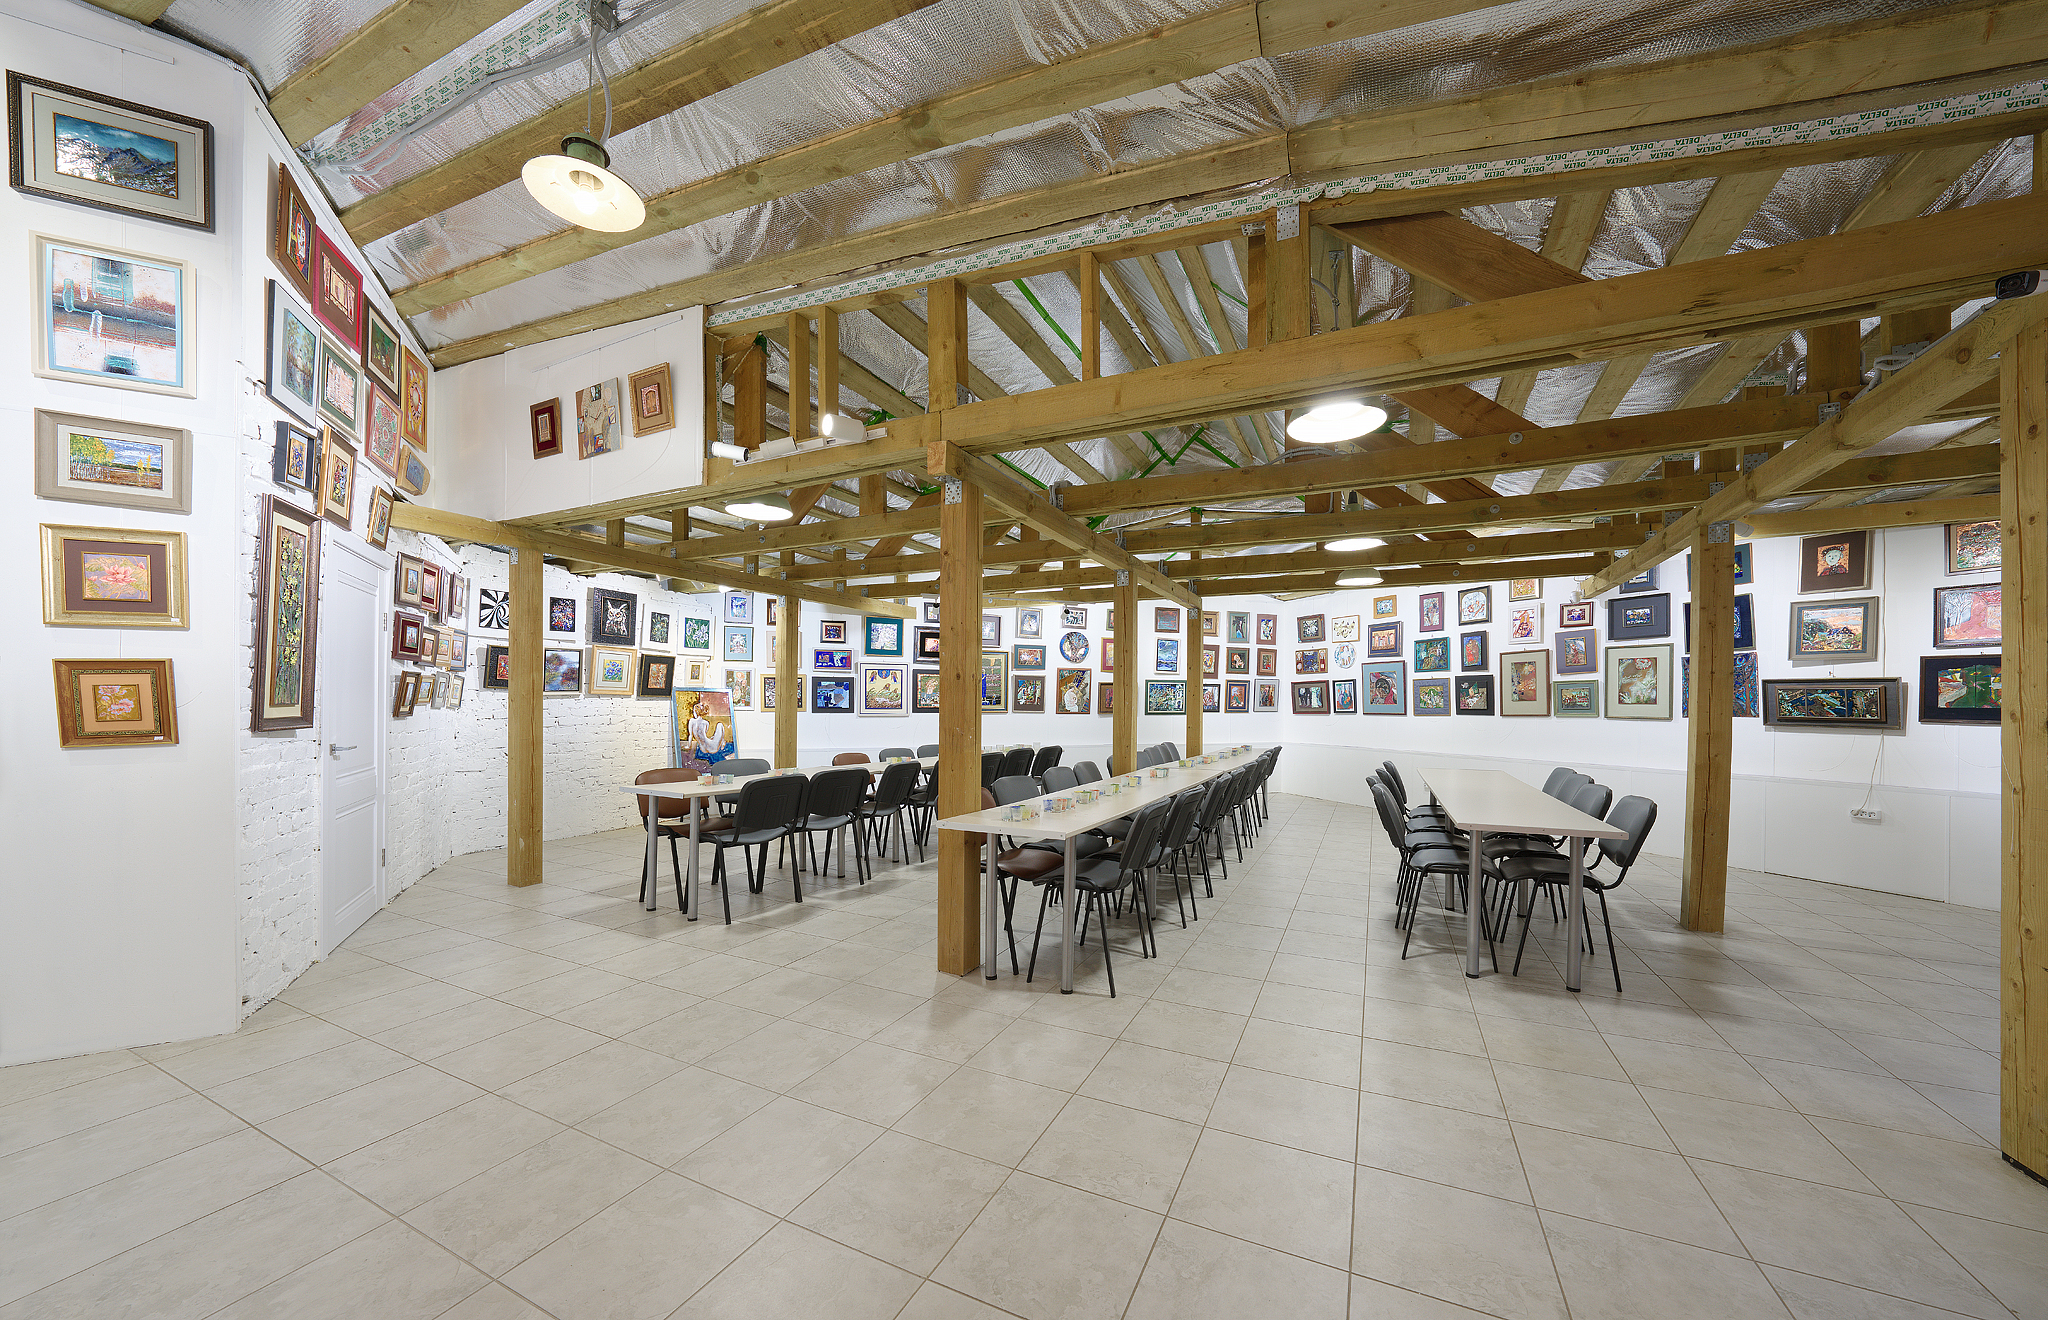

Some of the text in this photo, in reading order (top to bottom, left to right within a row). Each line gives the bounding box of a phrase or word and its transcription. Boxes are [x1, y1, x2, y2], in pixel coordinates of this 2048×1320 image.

[1978, 90, 2011, 101] DELTA
[1917, 100, 1949, 111] DELTA
[2006, 98, 2040, 108] DELTA
[1860, 110, 1889, 120] DELTA
[1944, 108, 1976, 118] DELTA
[1816, 118, 1834, 126] DEL
[1885, 118, 1915, 127] DELTA
[1772, 124, 1799, 133] DELTA
[1830, 126, 1859, 135] DELTA
[1723, 131, 1748, 140] DELTA
[1675, 137, 1700, 146] DELTA
[1630, 143, 1654, 151] DELTA
[1696, 145, 1722, 153] DELTA
[1650, 151, 1674, 159] DELTA
